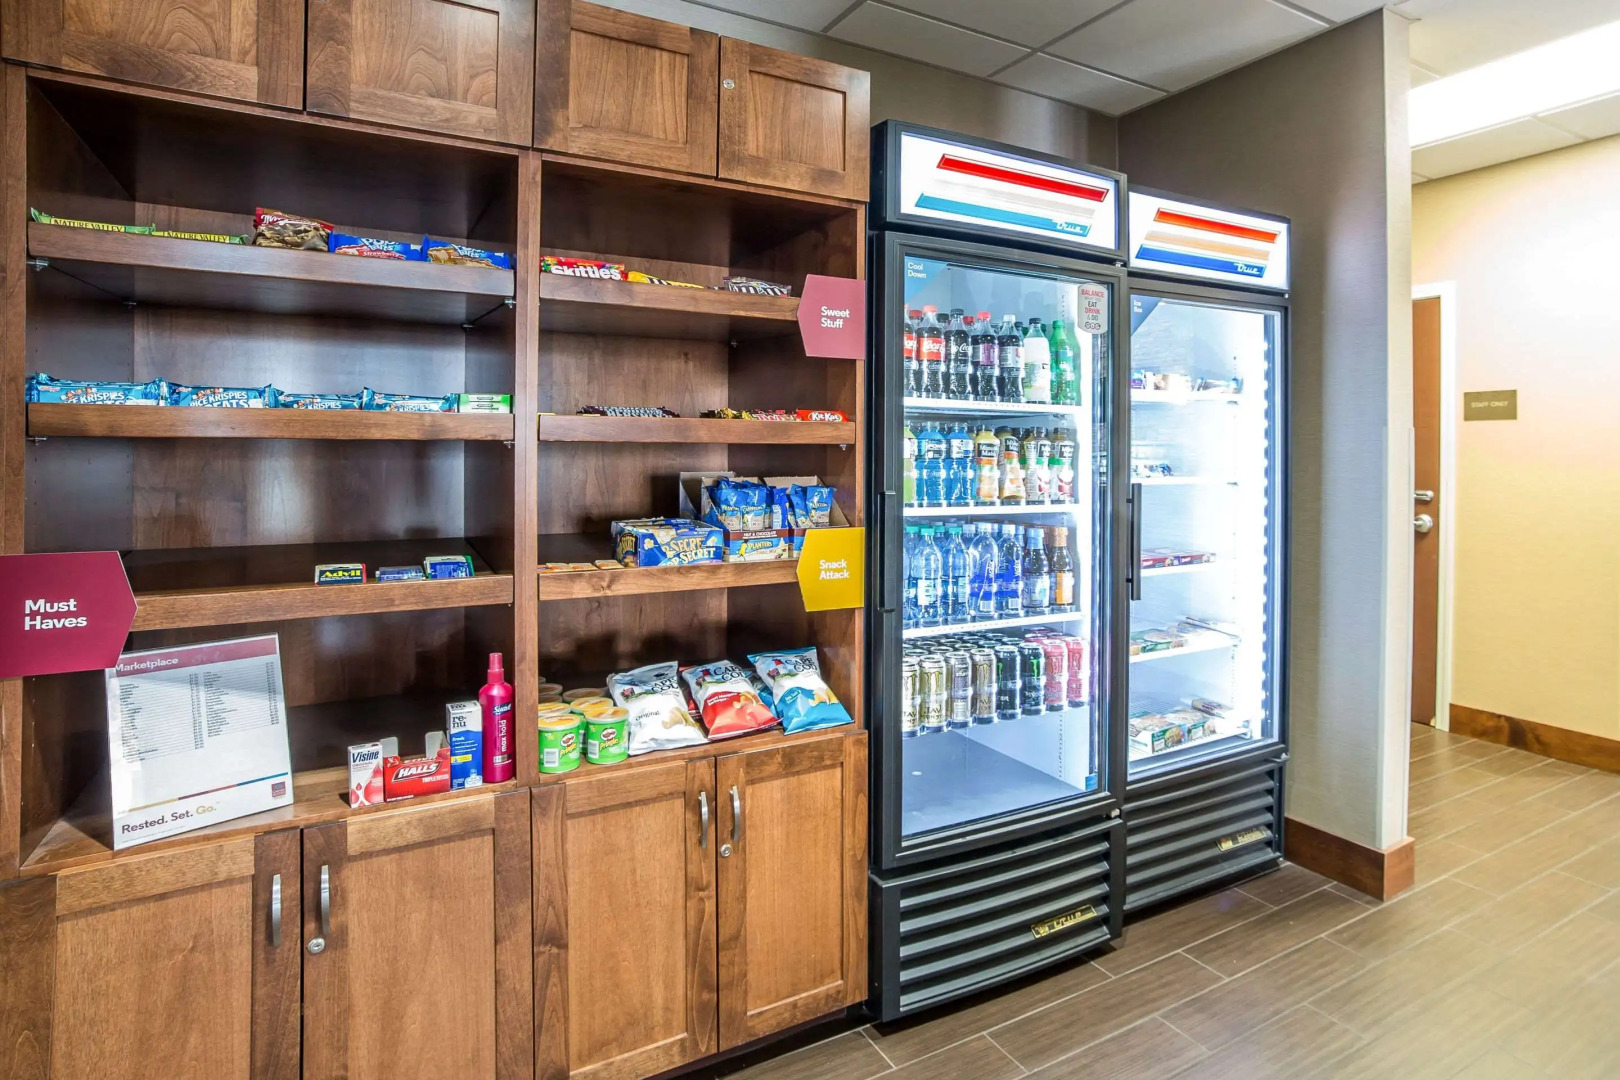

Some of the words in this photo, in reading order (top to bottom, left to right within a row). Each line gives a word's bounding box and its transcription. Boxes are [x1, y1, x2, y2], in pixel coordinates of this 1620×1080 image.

[54, 219, 89, 229] NATURE
[166, 231, 198, 240] NATURE
[551, 264, 621, 280] Skittles
[908, 262, 924, 271] Cool
[908, 270, 927, 279] Down
[1081, 288, 1105, 298] BALANCE
[1088, 300, 1098, 308] EAT
[821, 306, 850, 318] Sweet
[1085, 307, 1101, 315] DRINK
[821, 317, 844, 329] Stuff
[208, 391, 248, 403] KRISPIES
[680, 547, 716, 564] SECRET
[819, 559, 847, 569] Snack
[321, 570, 361, 578] Advil
[819, 569, 850, 580] Attack
[25, 598, 77, 614] Must
[24, 616, 88, 631] Haves
[115, 658, 179, 672] Marketplace
[785, 658, 814, 667] CAPE
[351, 750, 380, 763] Visine
[397, 762, 439, 779] HALLS
[121, 815, 168, 834] Rested.
[171, 810, 193, 823] Set.
[195, 804, 217, 816] Go.
